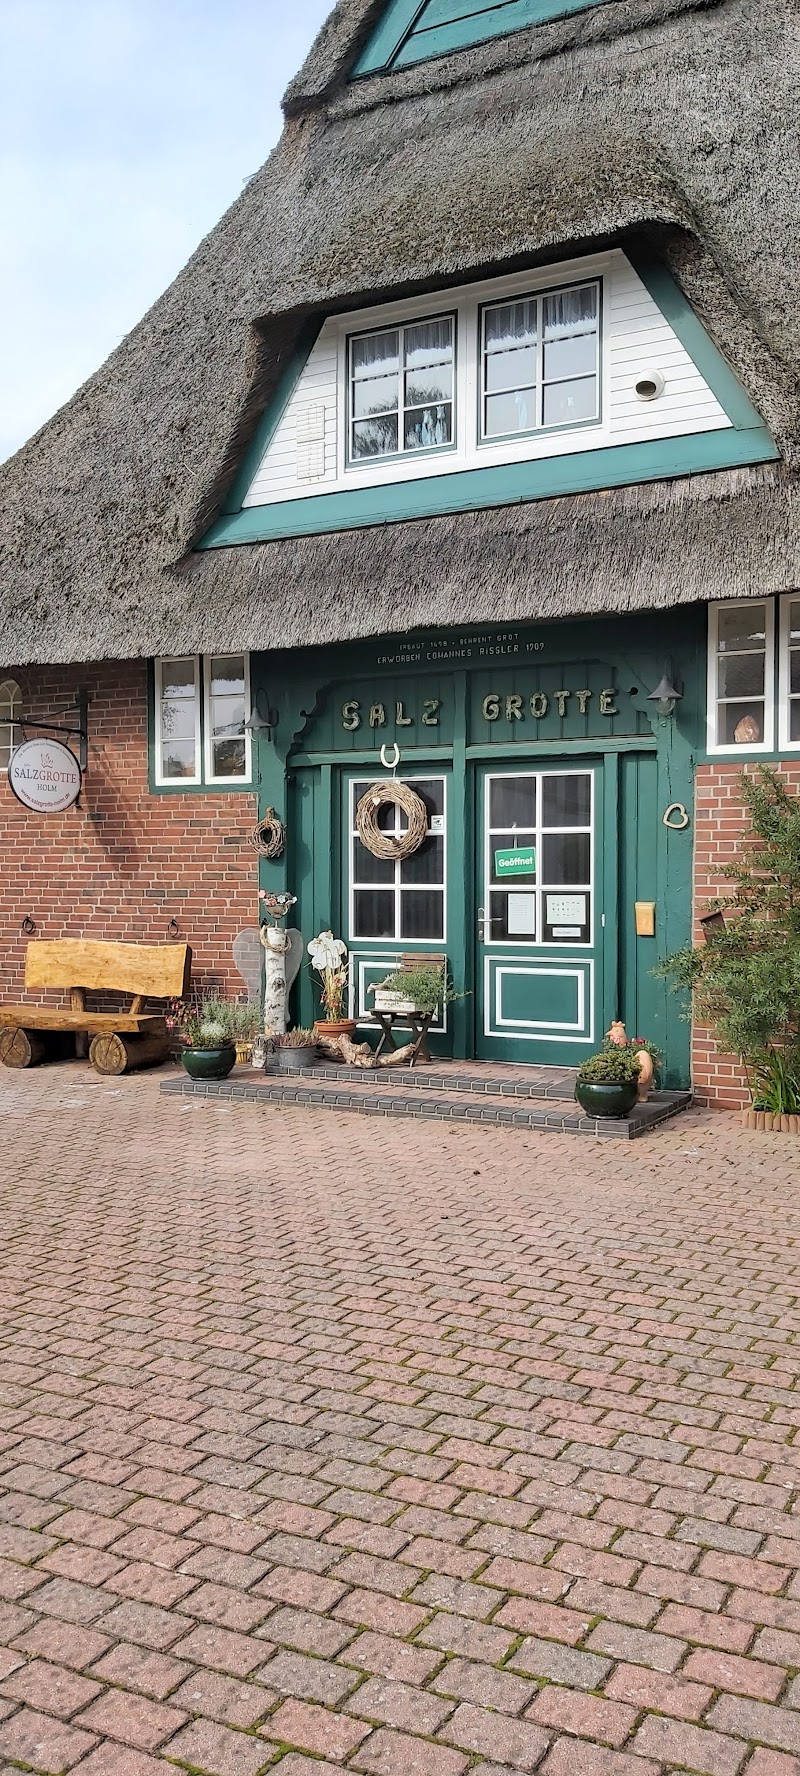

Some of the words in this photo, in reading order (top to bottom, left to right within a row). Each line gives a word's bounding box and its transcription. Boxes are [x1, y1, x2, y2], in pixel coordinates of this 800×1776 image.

[496, 633, 520, 642] GROT
[377, 653, 421, 664] ERWORBEN
[341, 699, 441, 732] SALZ
[481, 688, 618, 722] GROTTE
[14, 767, 77, 784] SALZGROTTE
[37, 783, 57, 792] HOLM
[498, 856, 534, 868] Geöffnet
